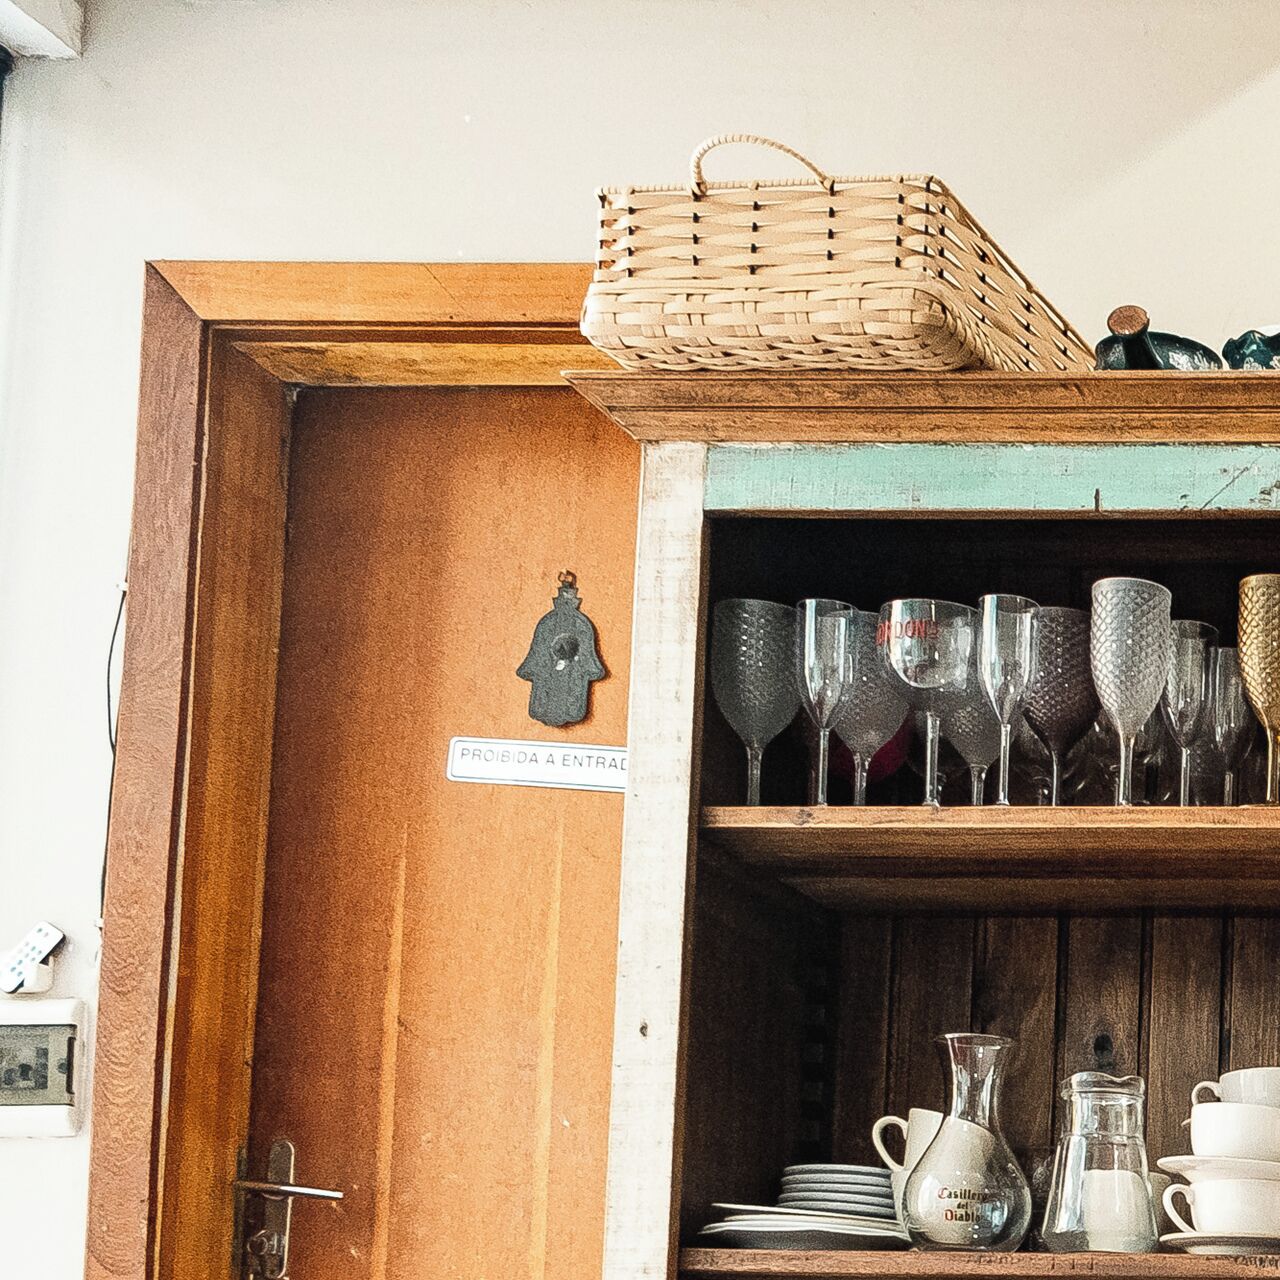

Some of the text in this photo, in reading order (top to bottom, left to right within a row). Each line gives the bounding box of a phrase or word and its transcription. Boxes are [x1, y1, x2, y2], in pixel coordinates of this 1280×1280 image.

[460, 747, 539, 764] PROIBIDA
[545, 752, 555, 765] A
[956, 1202, 969, 1210] del
